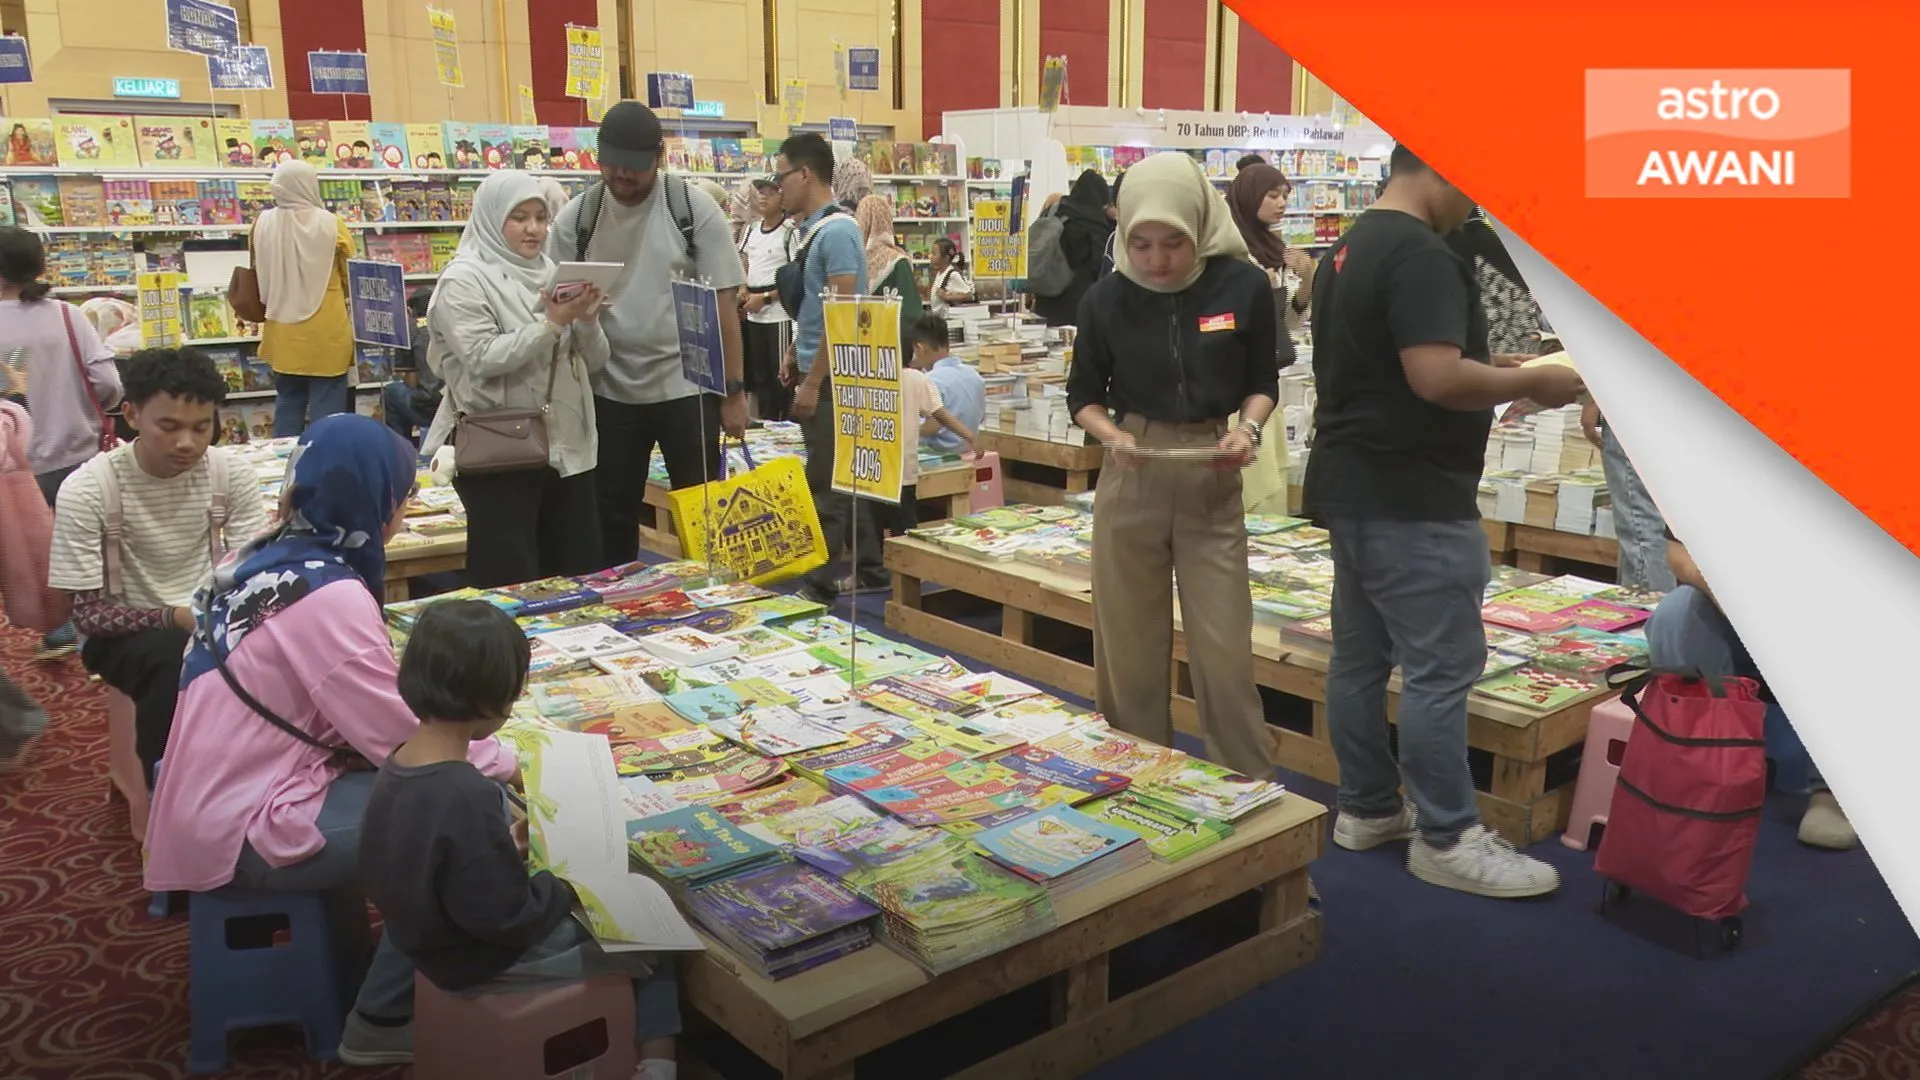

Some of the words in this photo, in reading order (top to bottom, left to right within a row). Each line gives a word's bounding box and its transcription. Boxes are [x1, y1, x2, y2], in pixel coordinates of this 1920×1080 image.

[115, 79, 166, 95] KELUAR
[1177, 123, 1191, 137] 70
[1194, 123, 1224, 137] Tahun
[1227, 124, 1250, 138] DBP:
[834, 344, 875, 378] JUDUL
[877, 347, 898, 381] AM
[835, 385, 866, 409] TAHUN
[867, 388, 898, 413] TERBIT
[872, 416, 895, 442] 2023
